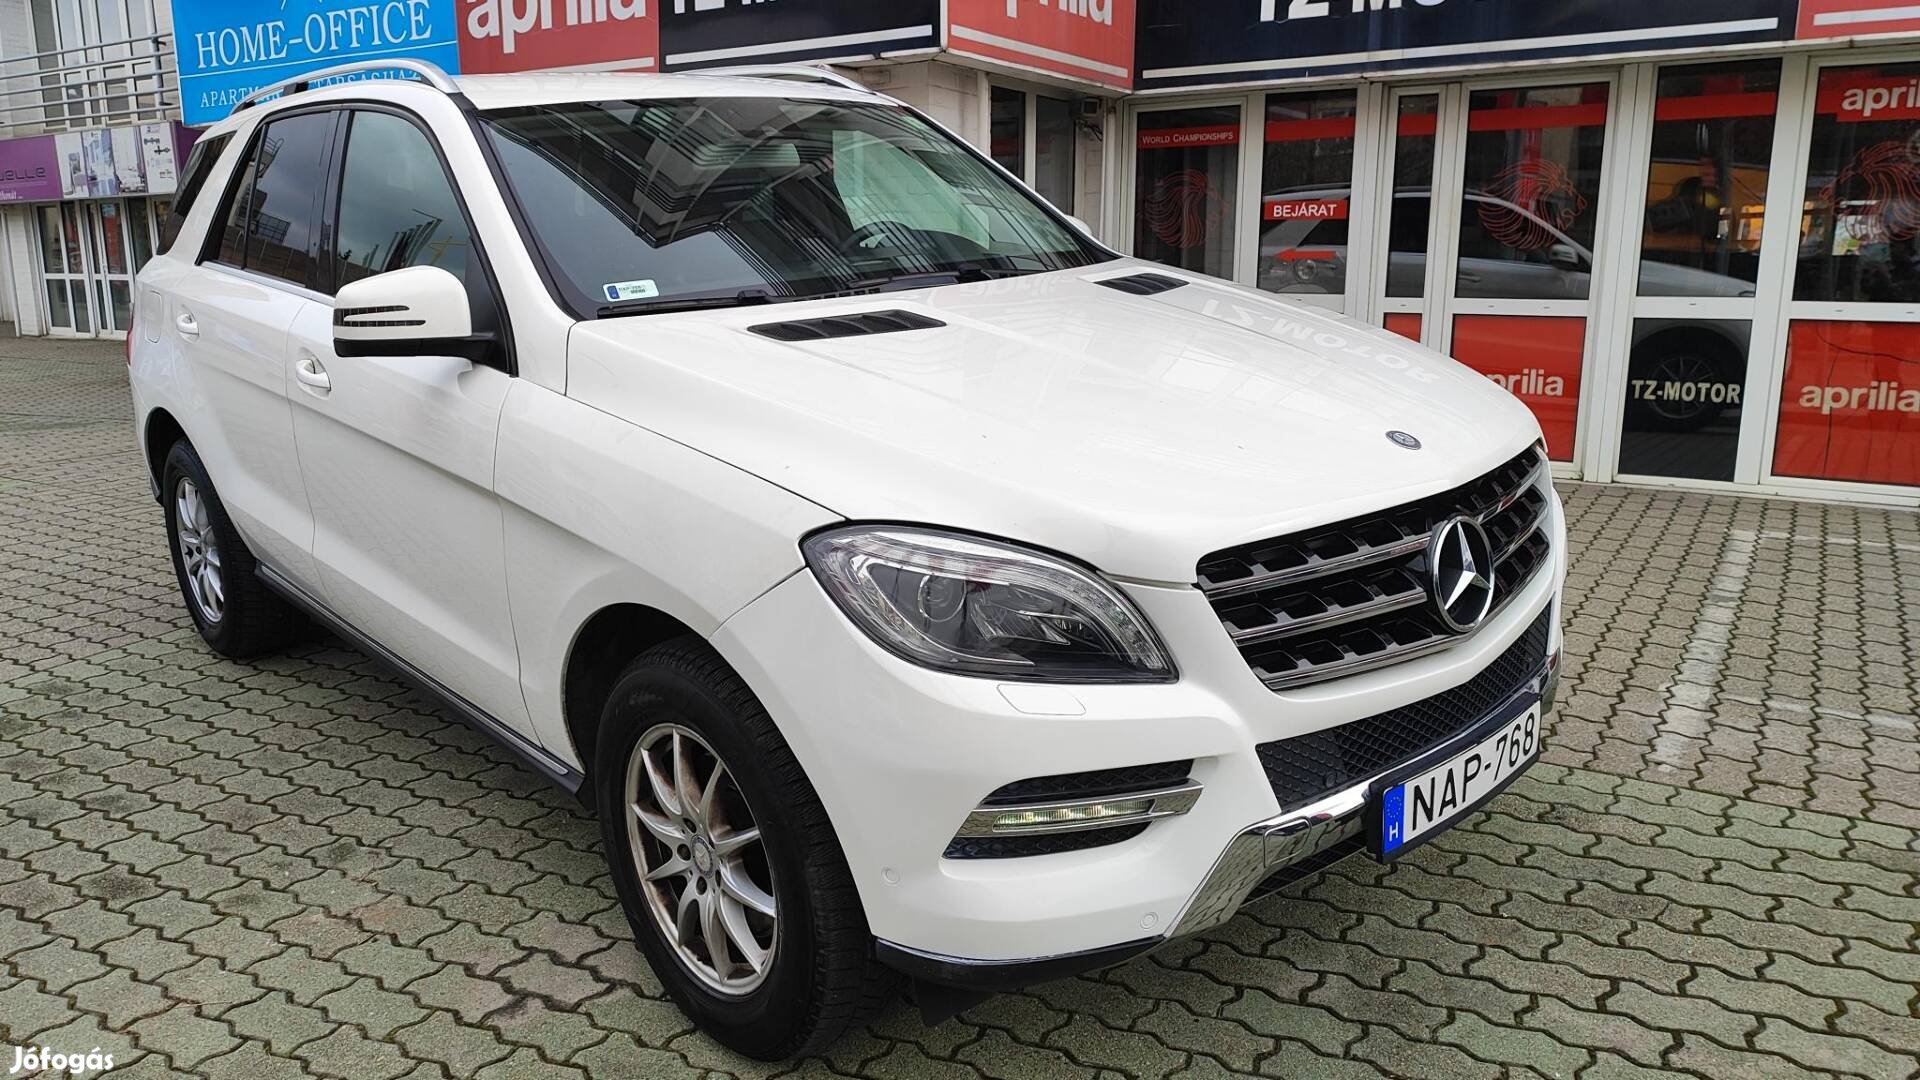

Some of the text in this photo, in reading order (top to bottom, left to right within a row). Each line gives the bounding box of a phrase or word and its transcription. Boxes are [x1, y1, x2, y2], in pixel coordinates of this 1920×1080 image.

[195, 0, 432, 69] HOME-OFFICE
[1142, 131, 1233, 144] WORLD CHAMPIONSHIPS
[1273, 202, 1337, 217] BEJÁRAT
[1631, 380, 1741, 404] TZ-MOTOR
[1799, 381, 1920, 415] aprilia
[1412, 712, 1535, 831] NAP-768
[1389, 822, 1399, 842] H
